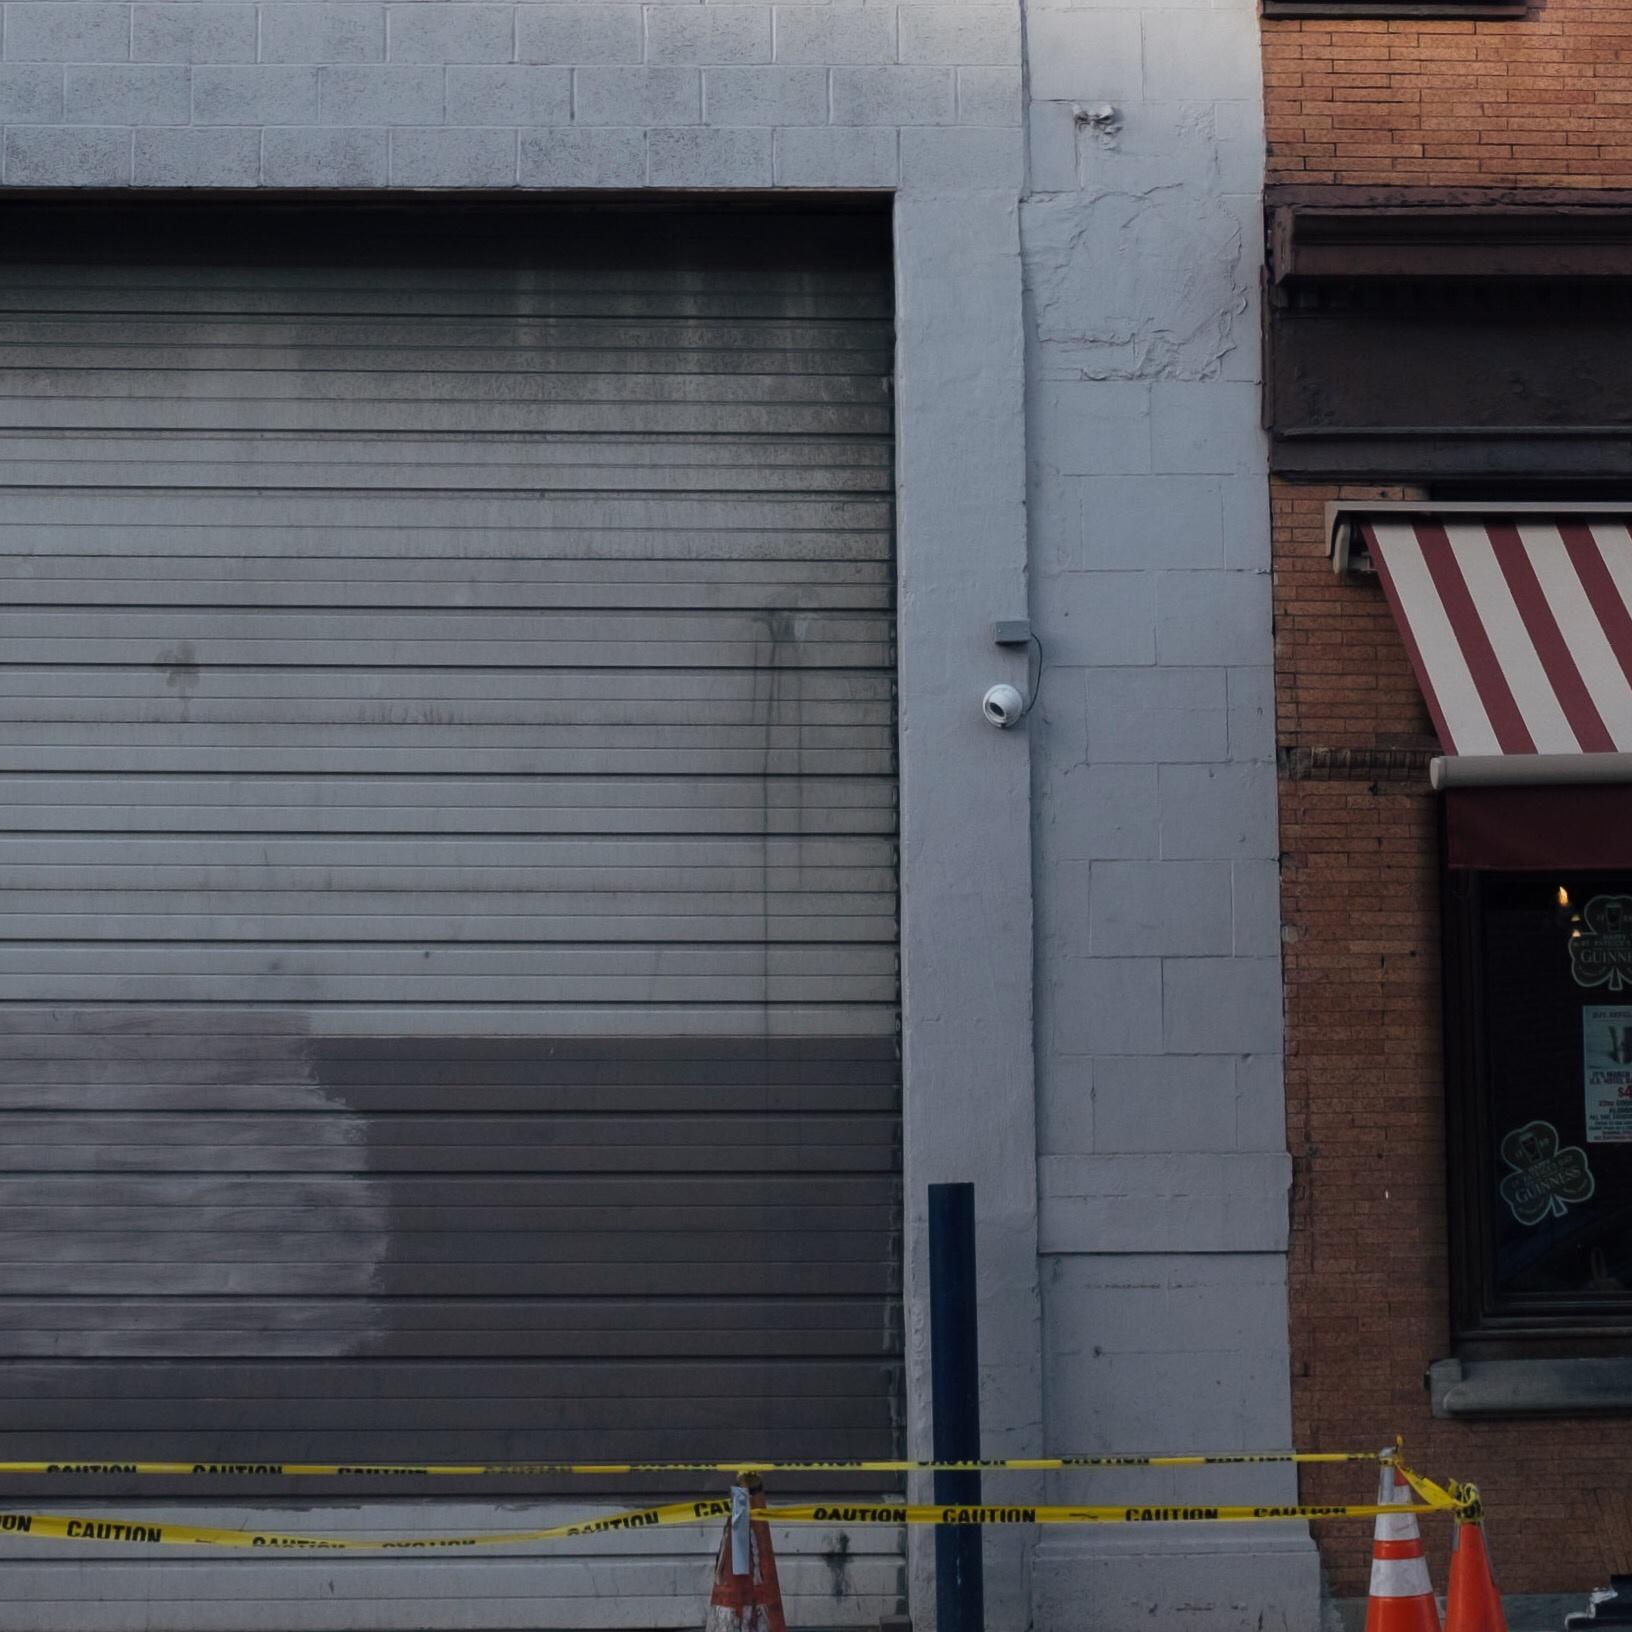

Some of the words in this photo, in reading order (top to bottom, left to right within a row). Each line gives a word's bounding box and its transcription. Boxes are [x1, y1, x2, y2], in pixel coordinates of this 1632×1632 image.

[1617, 1084, 1632, 1098] $4
[1515, 1168, 1582, 1203] GUINNESS
[813, 1507, 906, 1522] CAUTION
[941, 1507, 1036, 1525] CAUTION
[1125, 1507, 1219, 1522] CAUTION
[66, 1519, 162, 1543] CAUTION
